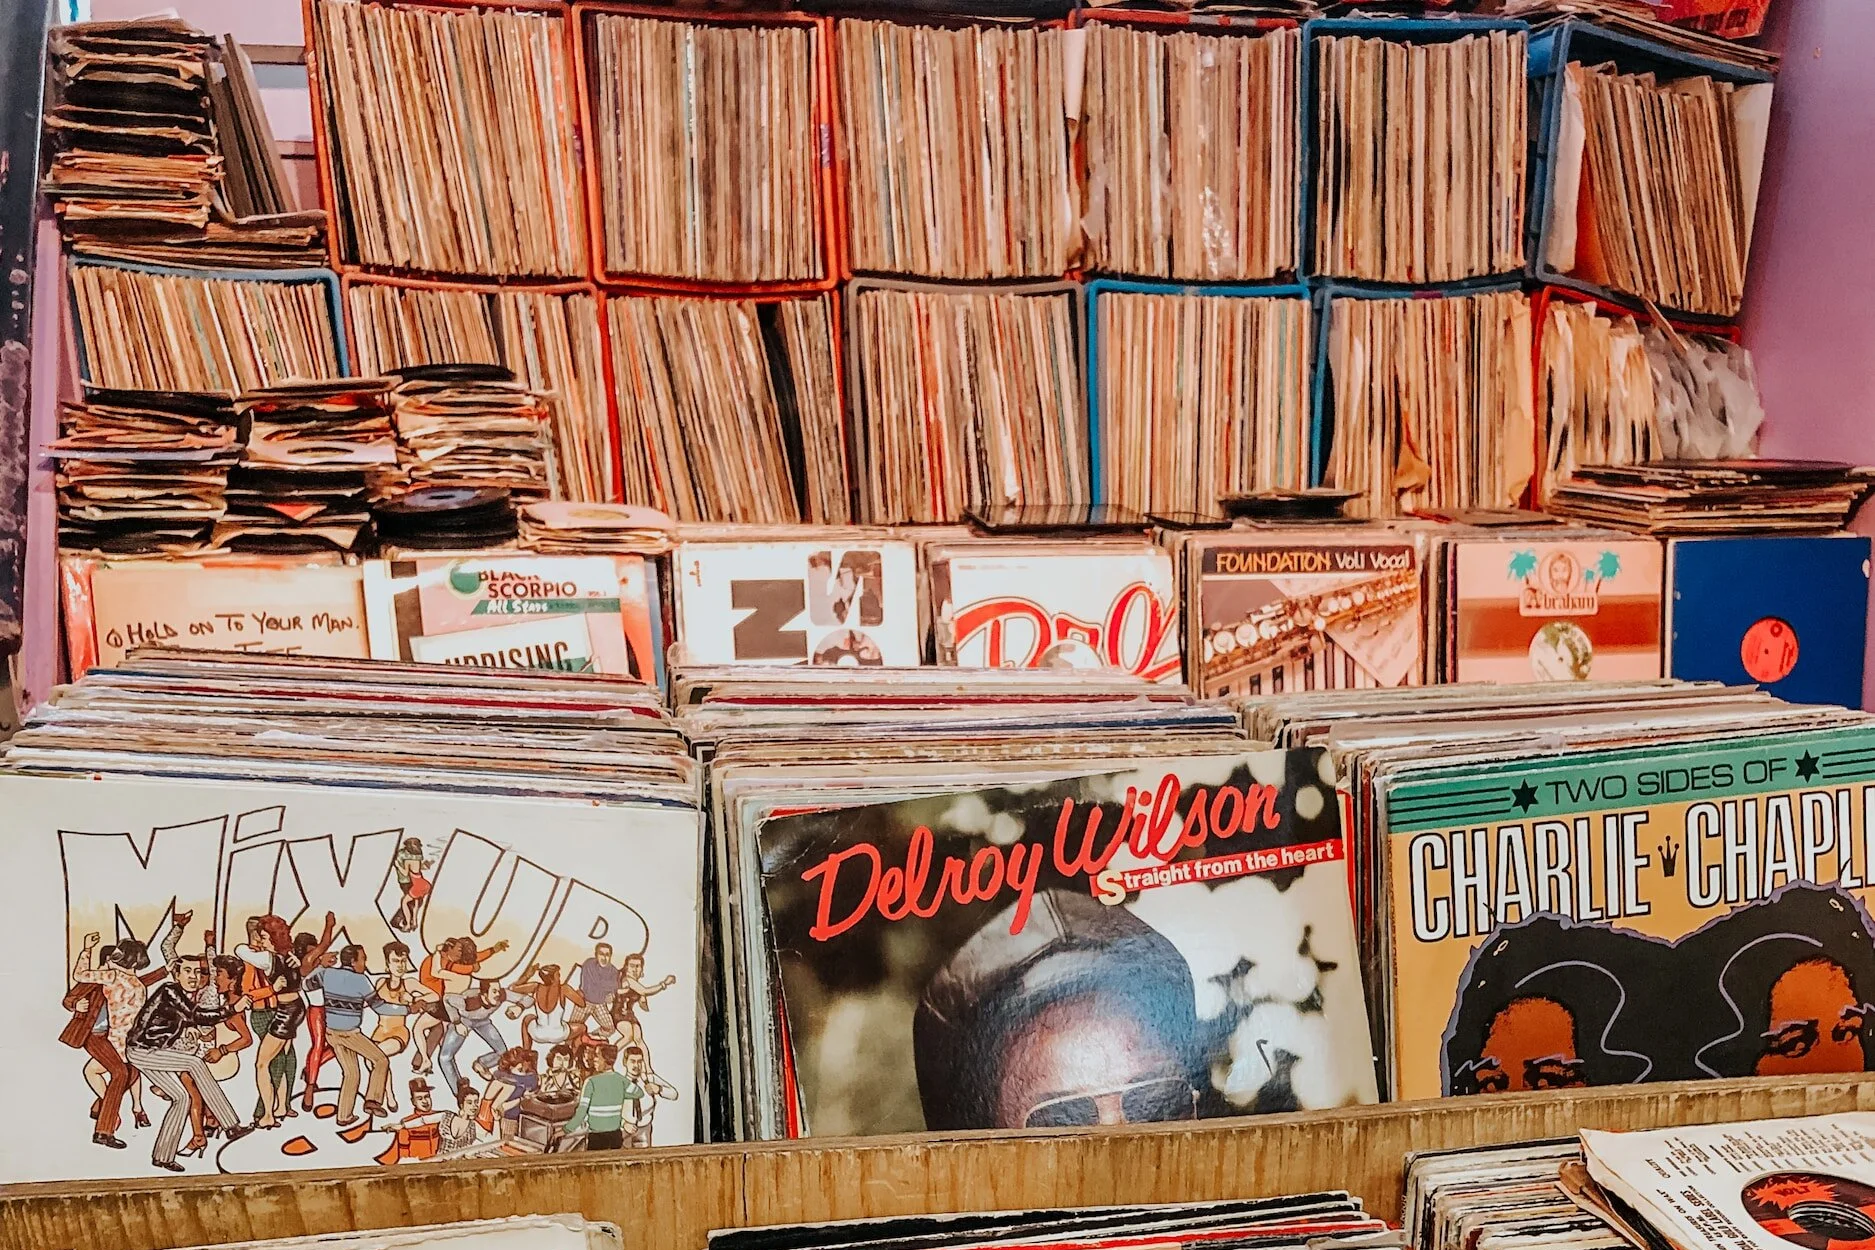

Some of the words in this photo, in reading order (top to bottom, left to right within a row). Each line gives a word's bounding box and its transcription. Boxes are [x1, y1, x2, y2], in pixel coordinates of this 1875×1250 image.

[1216, 551, 1332, 572] FOUNDATION
[1369, 549, 1410, 570] Vocal
[487, 581, 577, 599] SCORPIO
[1524, 588, 1595, 610] Abraham
[127, 622, 178, 644] HOLD
[189, 621, 214, 635] ON
[215, 613, 245, 631] TO
[252, 611, 303, 634] YOUR
[445, 641, 569, 671] RISING
[1545, 775, 1627, 804] TWO
[1637, 763, 1734, 797] SIDES
[1743, 757, 1788, 784] OF
[800, 825, 1043, 943] Delroy
[1051, 772, 1282, 877] Wilson
[1095, 862, 1191, 907] Straight
[1193, 855, 1244, 881] from
[1245, 851, 1279, 872] the
[1280, 843, 1336, 867] heart
[1408, 810, 1652, 943] CHARLIE
